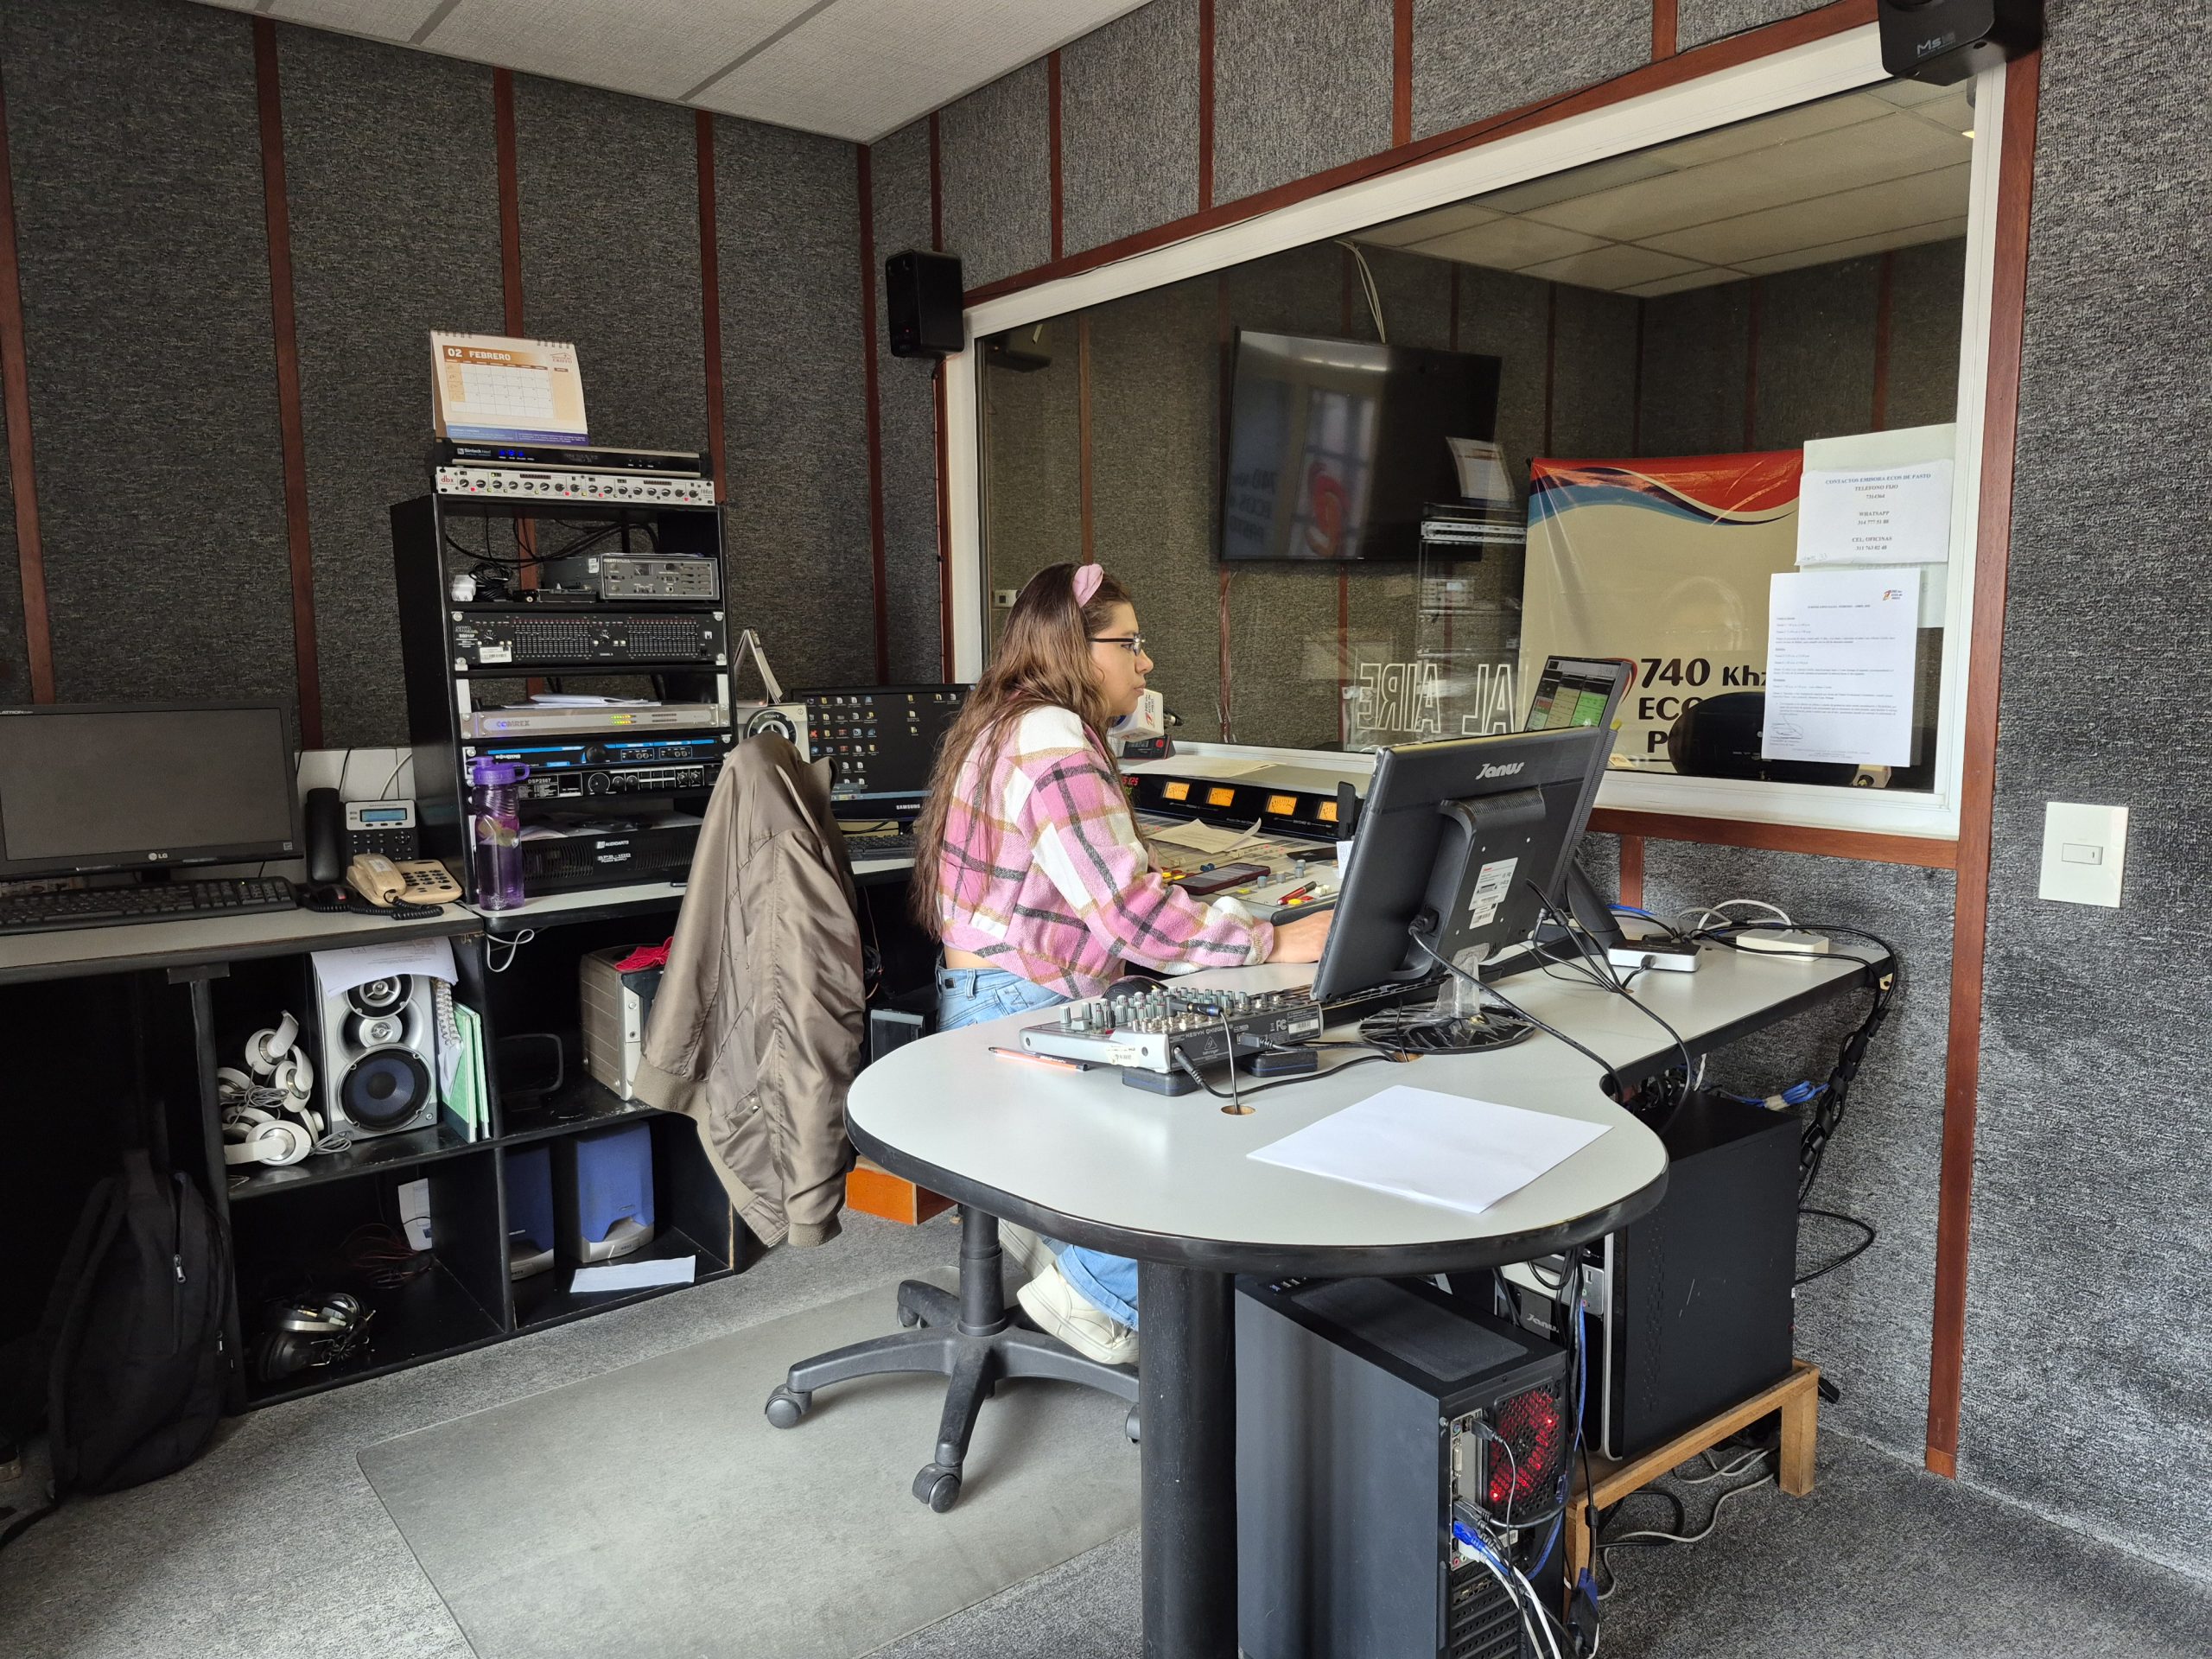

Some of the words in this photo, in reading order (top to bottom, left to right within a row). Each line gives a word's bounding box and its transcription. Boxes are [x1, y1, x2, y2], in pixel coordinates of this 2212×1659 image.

[448, 347, 463, 358] 02
[469, 350, 512, 361] FEBRERO
[1641, 658, 1711, 689] 740
[1475, 762, 1525, 780] Janus
